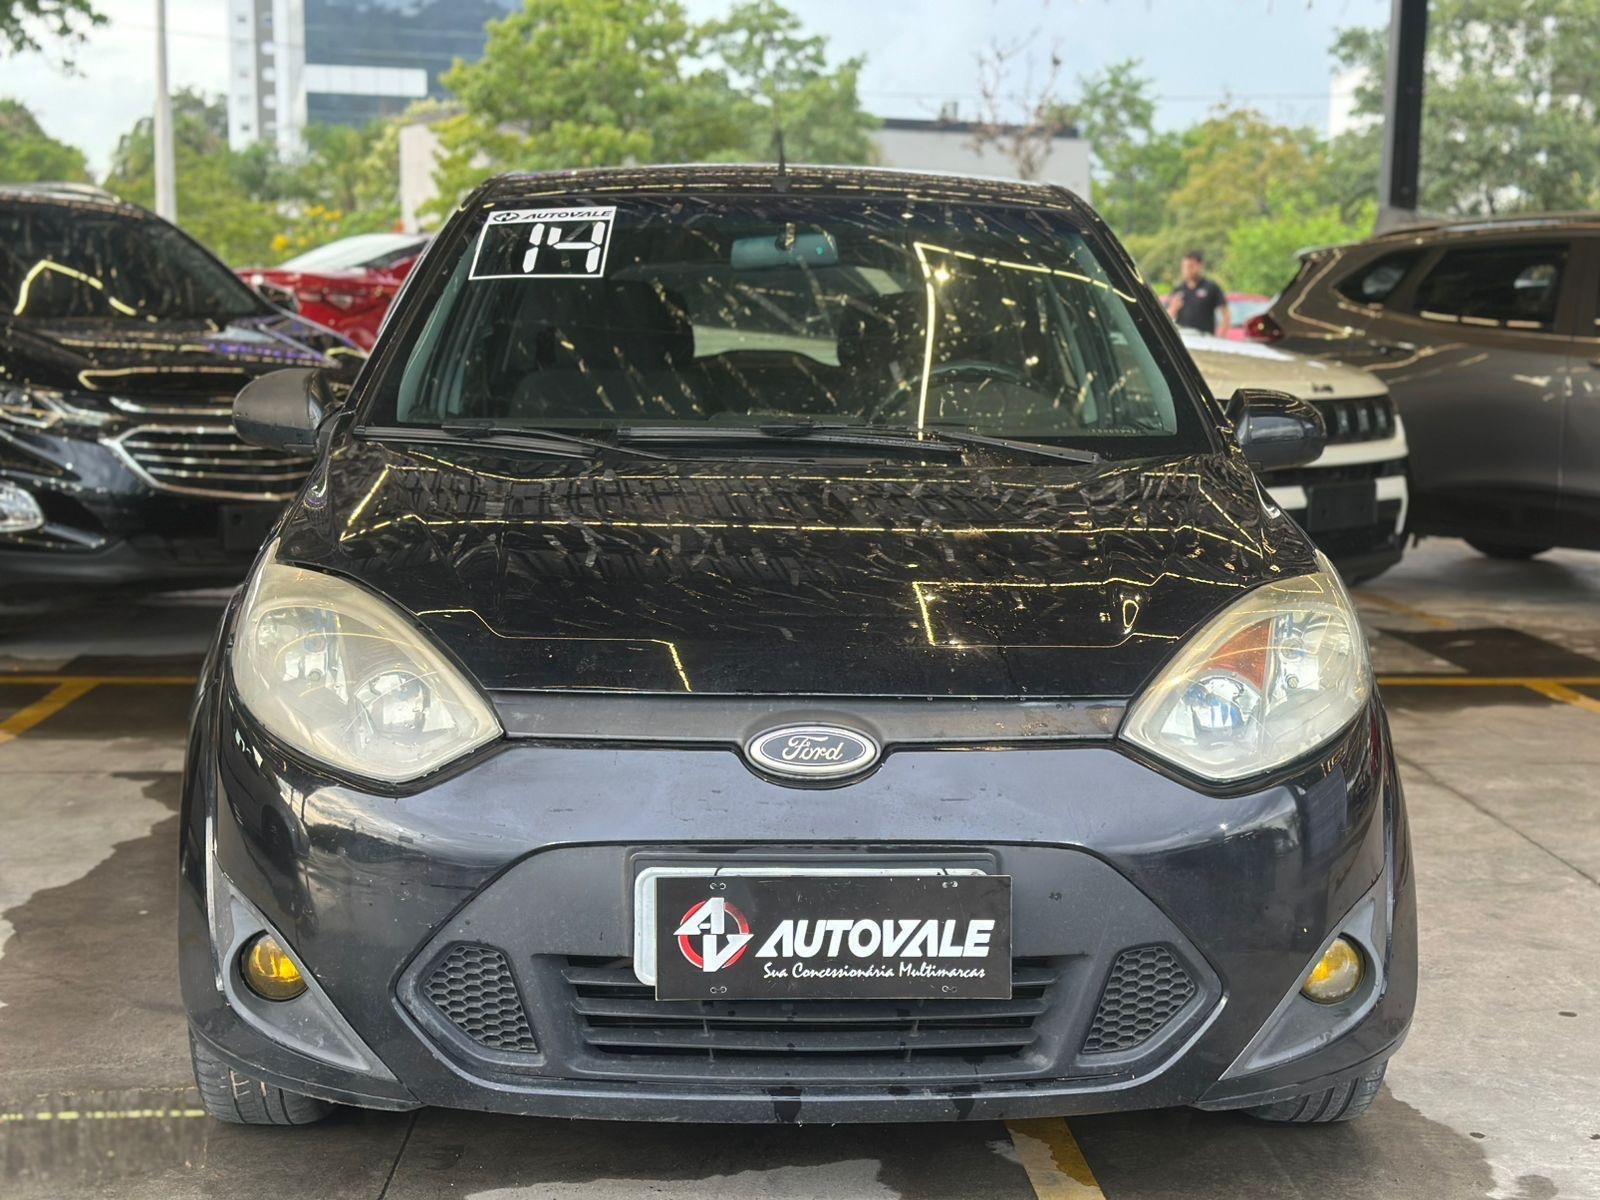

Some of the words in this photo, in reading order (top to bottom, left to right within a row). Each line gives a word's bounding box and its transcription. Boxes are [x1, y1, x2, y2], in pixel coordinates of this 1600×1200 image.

[522, 210, 613, 220] AUTOVALE
[522, 221, 606, 274] 14
[782, 735, 844, 760] Ford
[755, 918, 996, 958] AUTOVALE
[763, 961, 788, 979] Sua
[791, 961, 895, 979] Concessionária
[899, 961, 986, 979] Multimarcas
